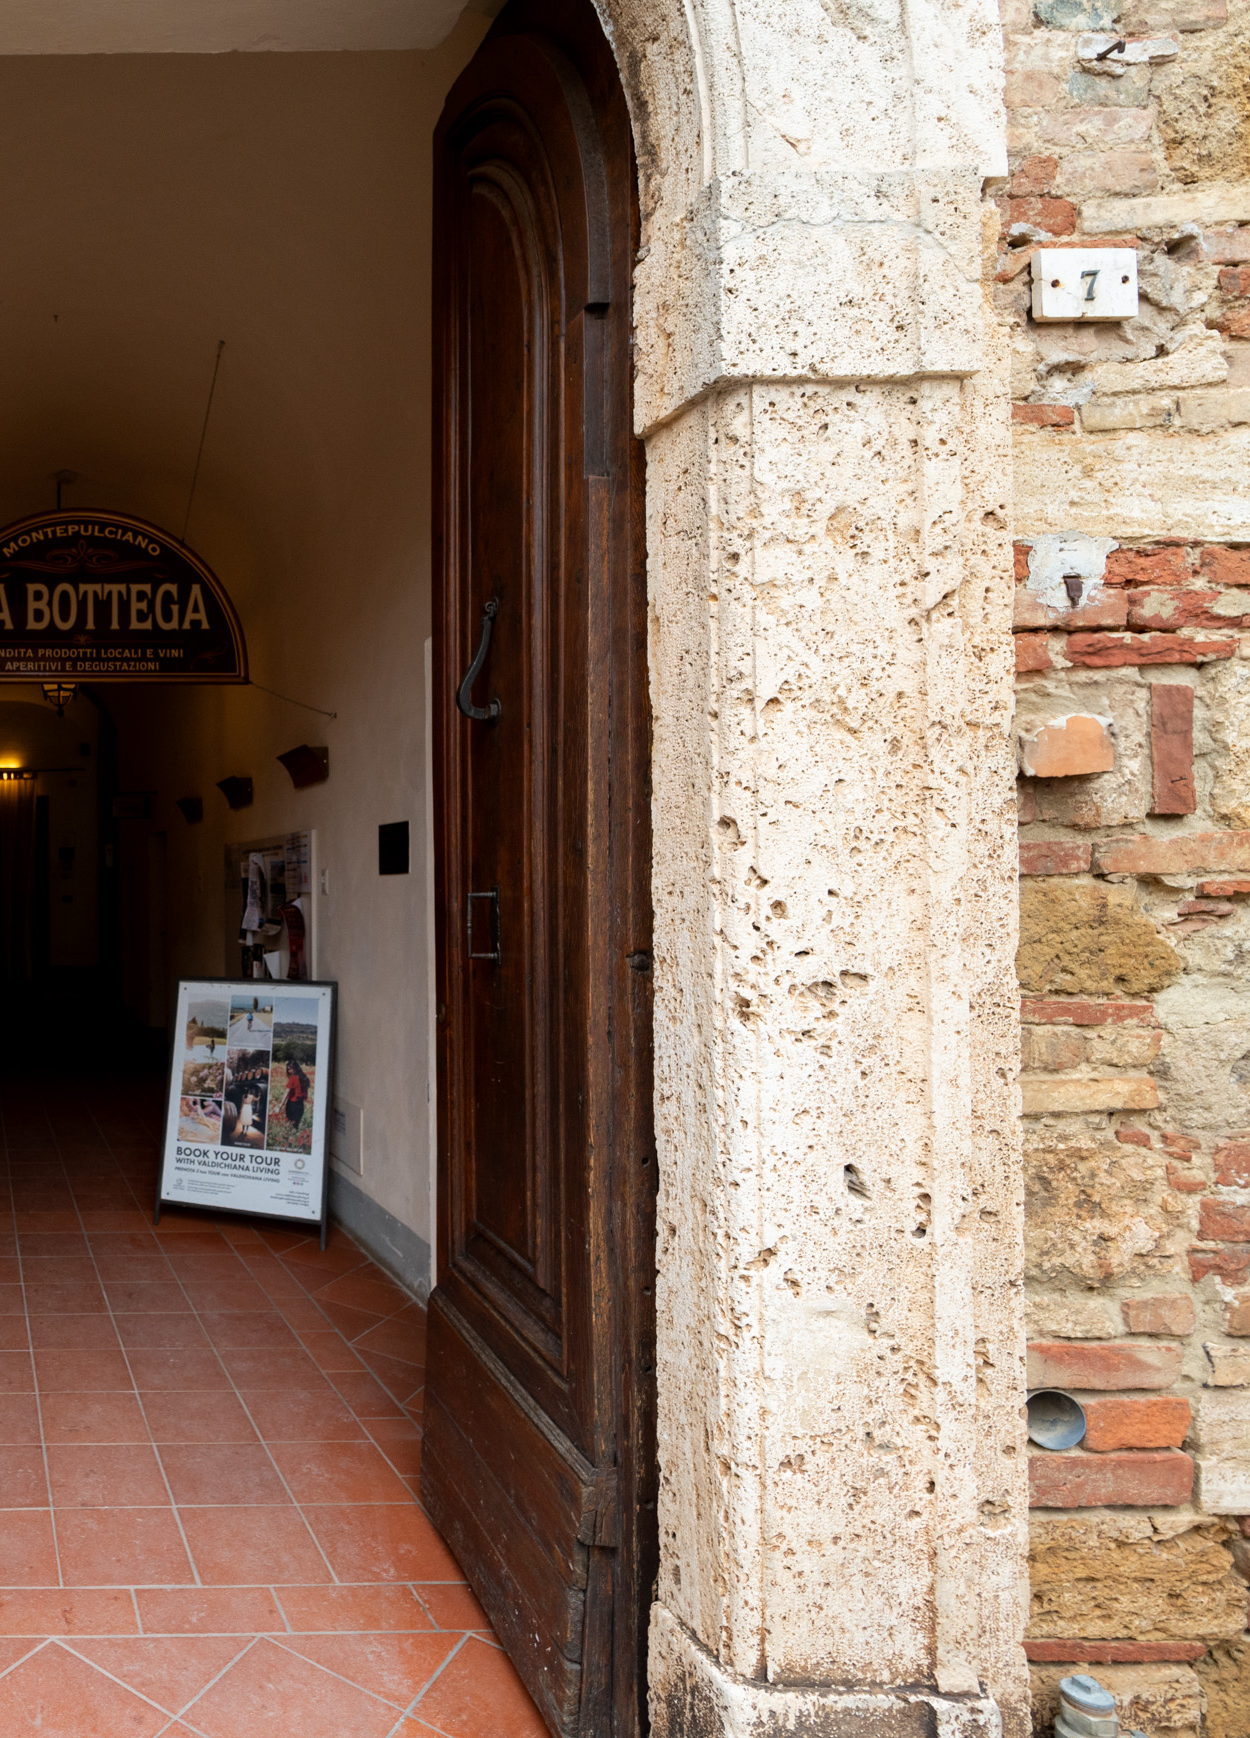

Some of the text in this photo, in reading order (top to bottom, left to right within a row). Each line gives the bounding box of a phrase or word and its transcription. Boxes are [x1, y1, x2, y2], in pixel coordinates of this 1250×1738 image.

[1080, 269, 1101, 301] 7
[1, 525, 161, 558] MONTEPULCIANO
[25, 583, 211, 630] BOTTEGA
[38, 648, 97, 658] PRODOTTI
[101, 648, 142, 658] LOCALI
[146, 648, 154, 658] E
[158, 648, 184, 658] VINI
[4, 661, 160, 671] APERITIVI E DEGUSTAZIONI
[175, 1157, 195, 1166] WITH
[196, 1159, 250, 1173] VALDICHIANA
[252, 1166, 281, 1176] LIVING
[176, 1146, 281, 1167] BOOK YOUR TOUR
